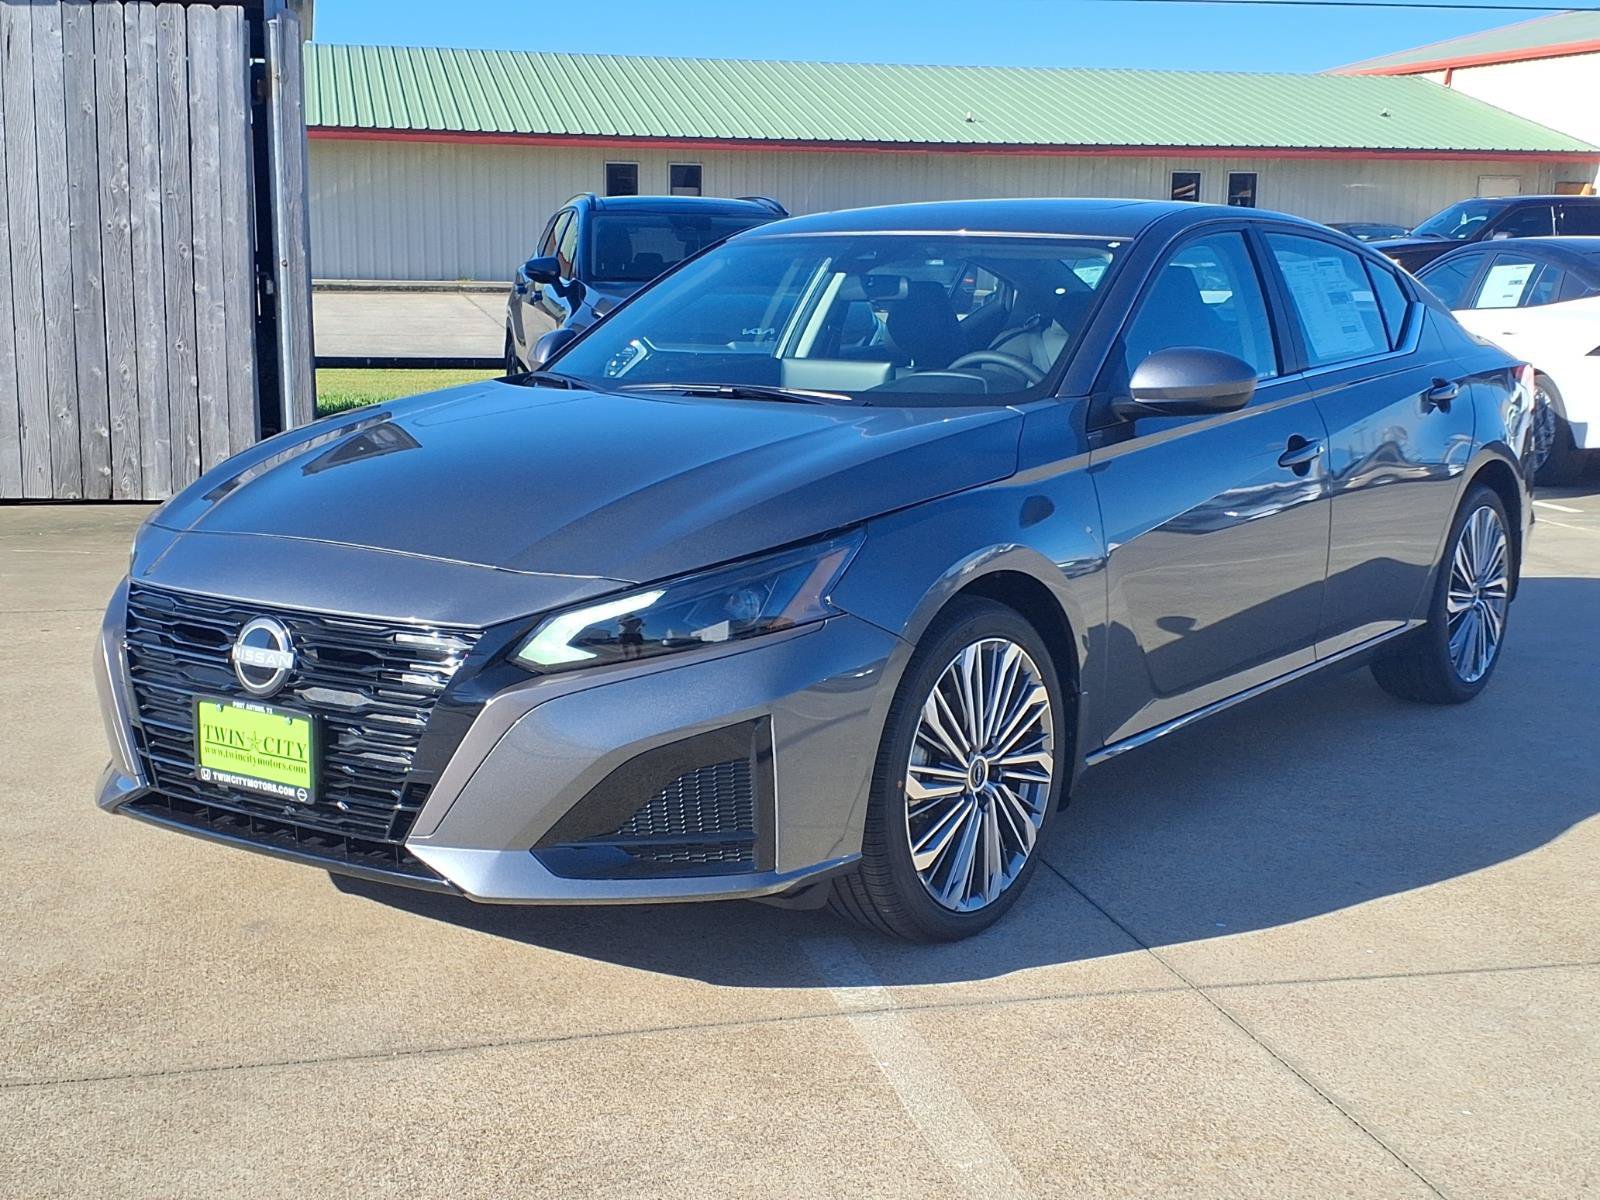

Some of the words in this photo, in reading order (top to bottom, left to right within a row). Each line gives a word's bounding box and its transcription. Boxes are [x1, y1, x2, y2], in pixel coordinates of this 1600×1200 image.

[234, 645, 293, 668] NISSAN
[203, 723, 246, 747] TWIN
[264, 736, 307, 759] CITY
[204, 745, 307, 774] www.twincitymotors.com
[212, 771, 296, 797] TWINCITYMOTORS.COM
